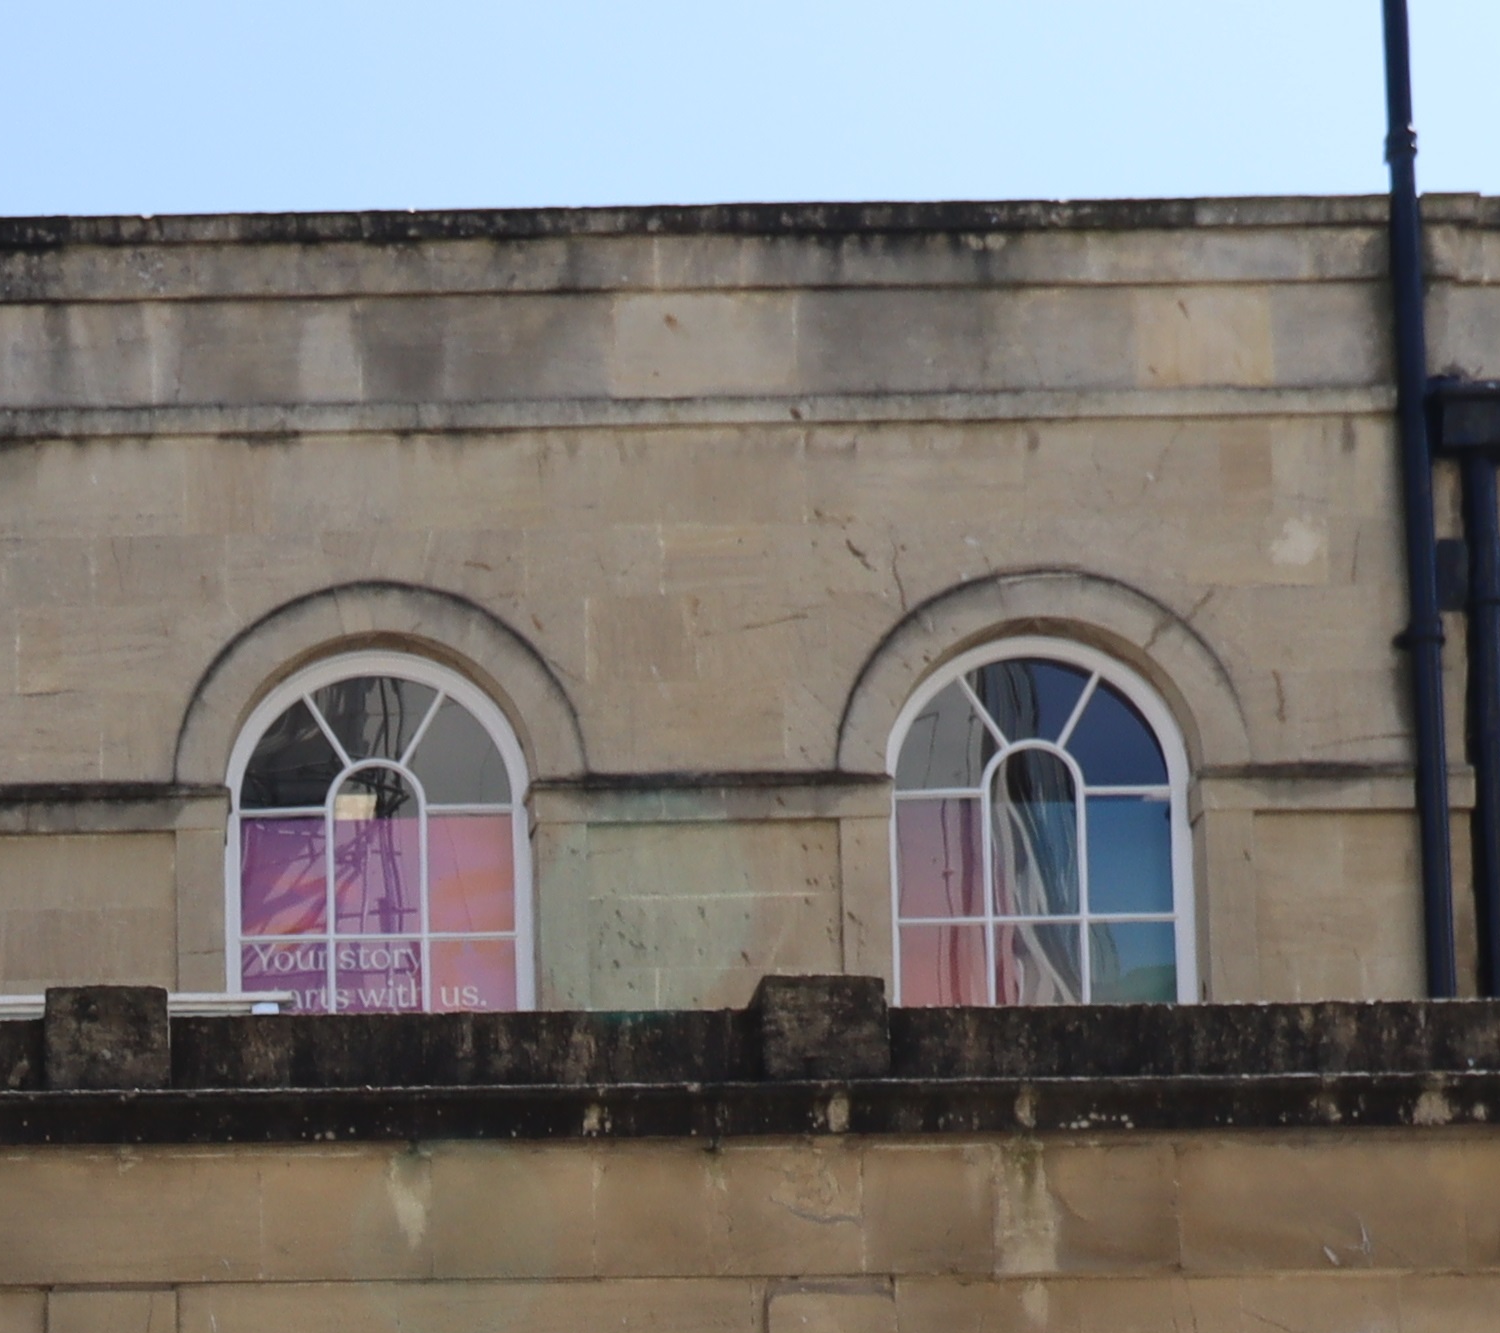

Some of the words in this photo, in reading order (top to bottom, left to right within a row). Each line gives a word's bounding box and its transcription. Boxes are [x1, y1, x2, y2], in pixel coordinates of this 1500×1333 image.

[252, 944, 328, 972] Your
[339, 945, 421, 977] story
[440, 984, 488, 1008] us.
